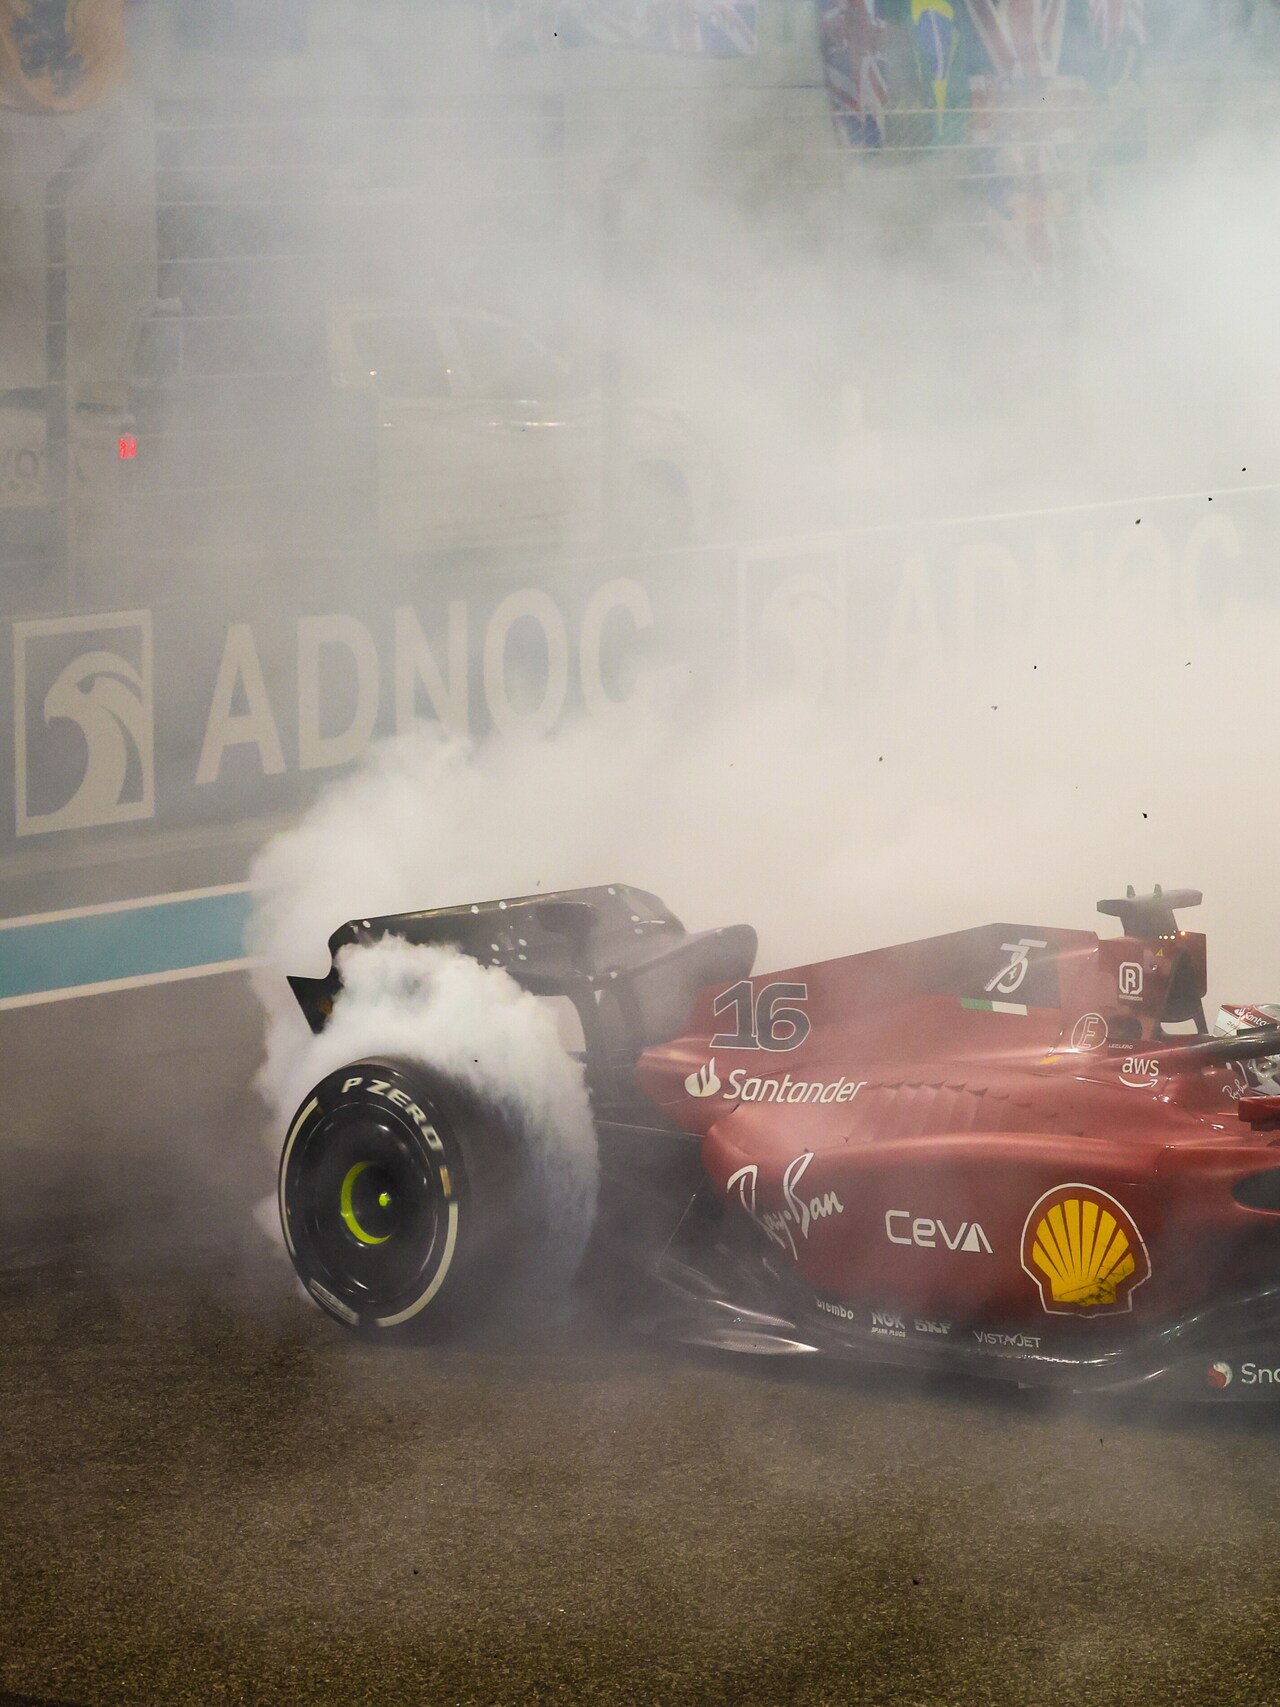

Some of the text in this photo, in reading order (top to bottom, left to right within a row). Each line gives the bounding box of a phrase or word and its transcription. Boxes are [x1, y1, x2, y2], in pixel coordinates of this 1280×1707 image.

[195, 577, 655, 784] ADNOC
[709, 980, 811, 1052] 16
[1122, 1057, 1159, 1077] aws
[723, 1069, 867, 1104] Santander
[871, 1311, 906, 1330] NGK
